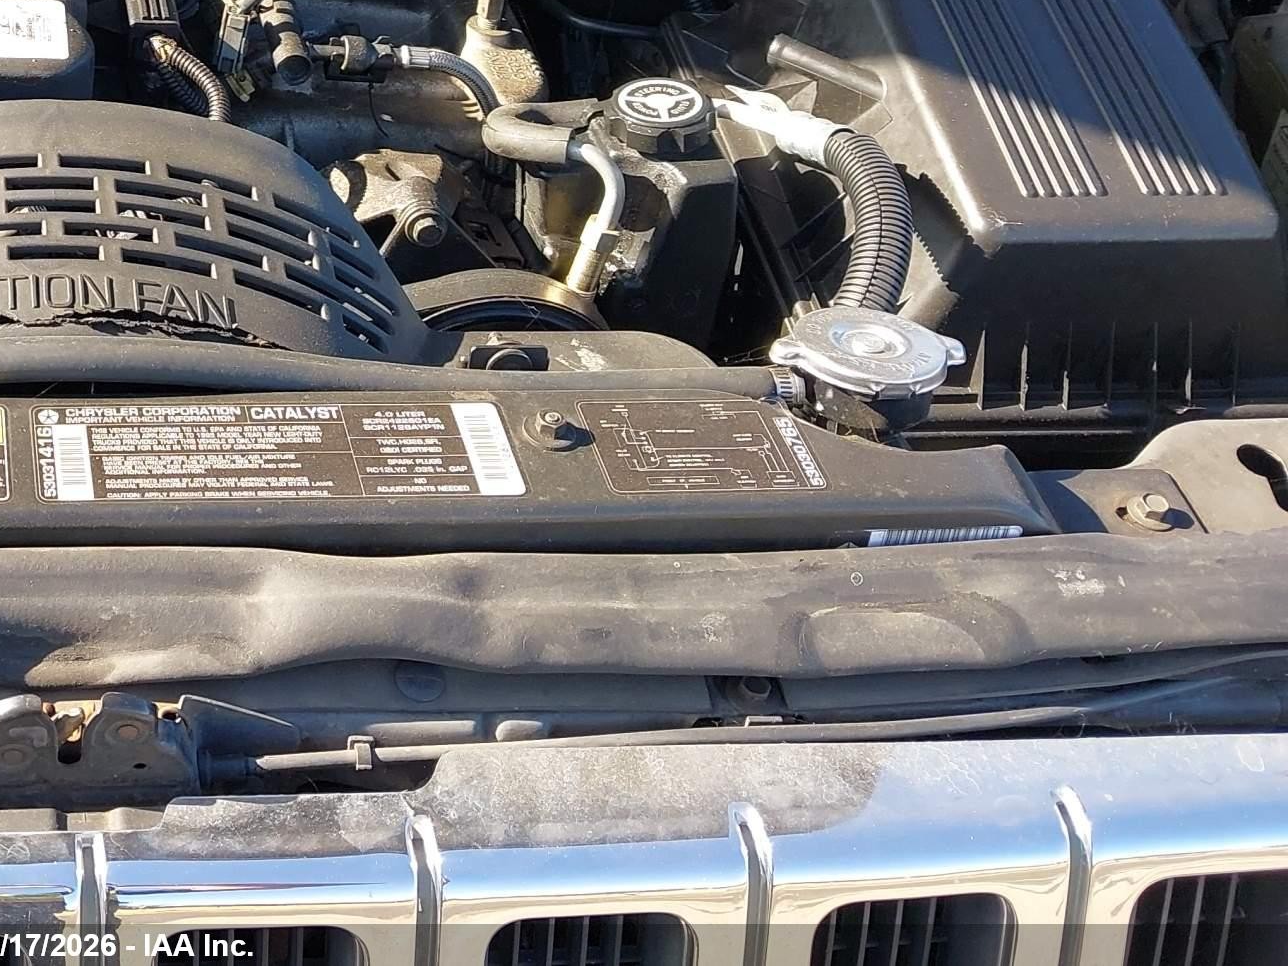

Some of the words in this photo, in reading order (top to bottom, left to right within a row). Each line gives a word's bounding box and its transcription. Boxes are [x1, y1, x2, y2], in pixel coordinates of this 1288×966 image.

[131, 276, 238, 330] FAN
[65, 408, 138, 416] CHRYSLER
[143, 406, 241, 418] CORPORATION
[250, 407, 338, 419] CATALYST
[37, 427, 56, 498] 53031416
[776, 417, 825, 486] 53030765
